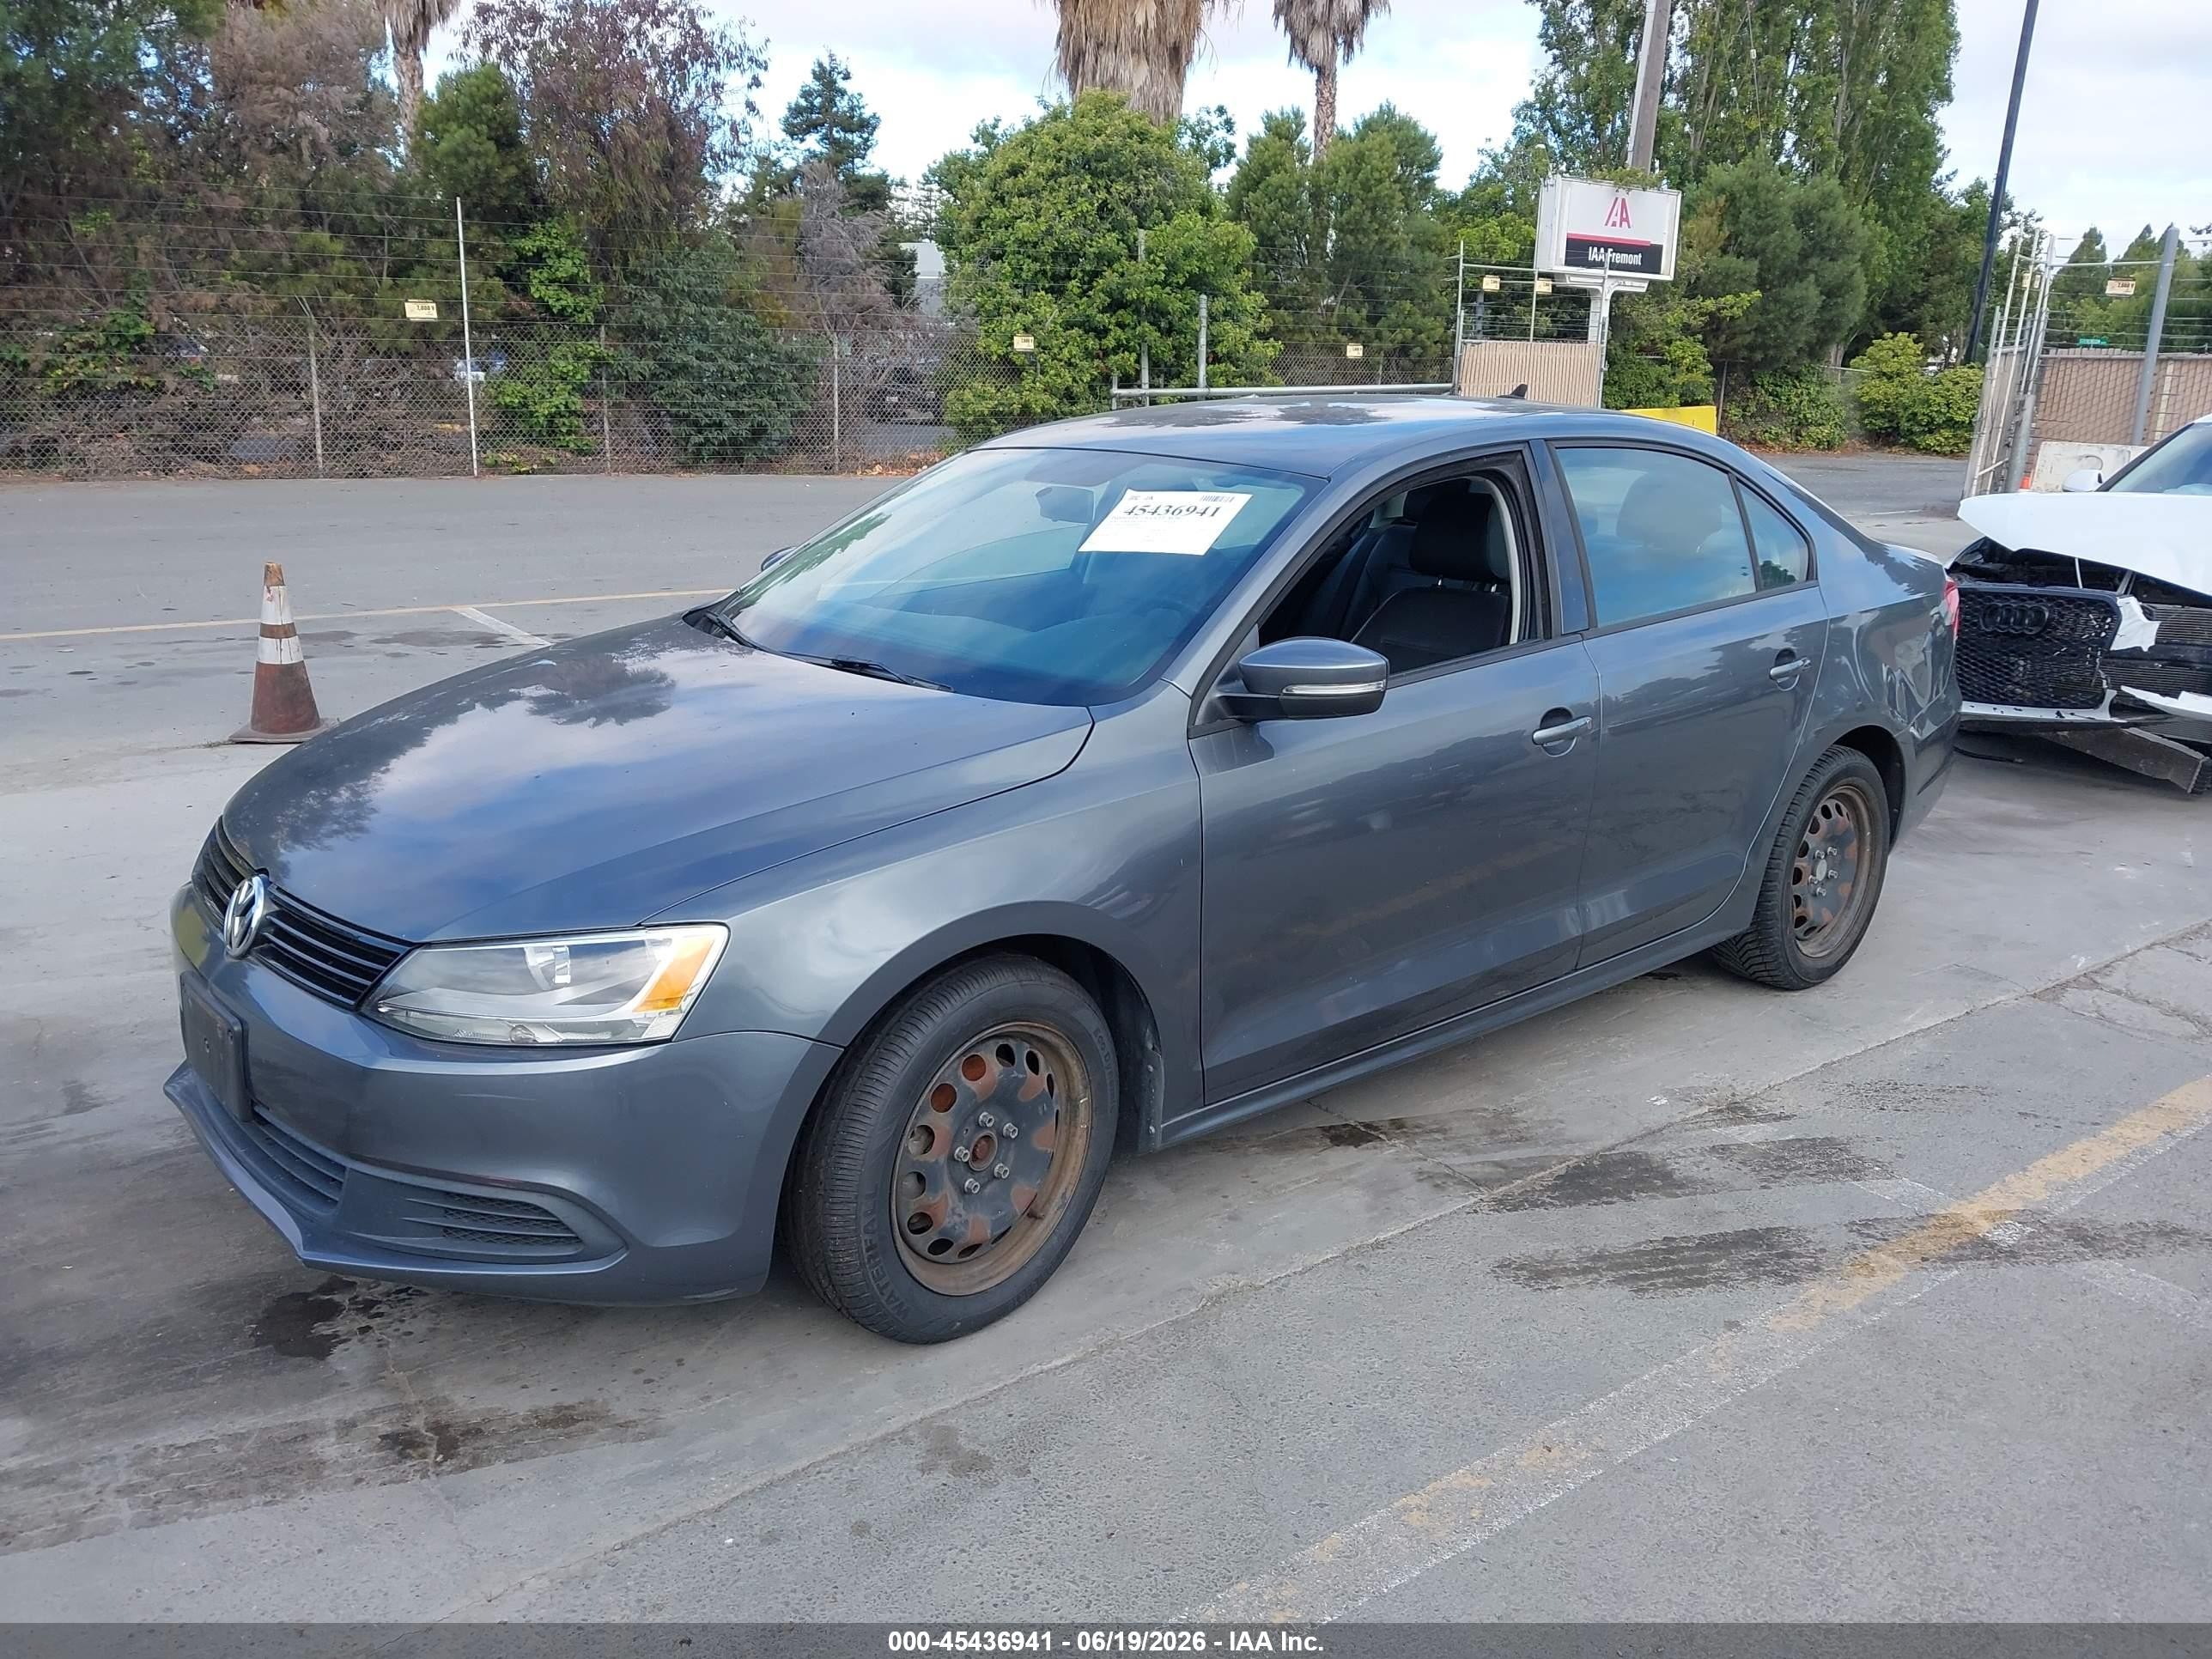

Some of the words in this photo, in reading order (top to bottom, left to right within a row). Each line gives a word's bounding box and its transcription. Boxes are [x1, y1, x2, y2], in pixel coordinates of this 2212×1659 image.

[1588, 246, 1605, 262] IAA
[1607, 247, 1643, 266] Fremont
[1123, 503, 1223, 518] 45436941
